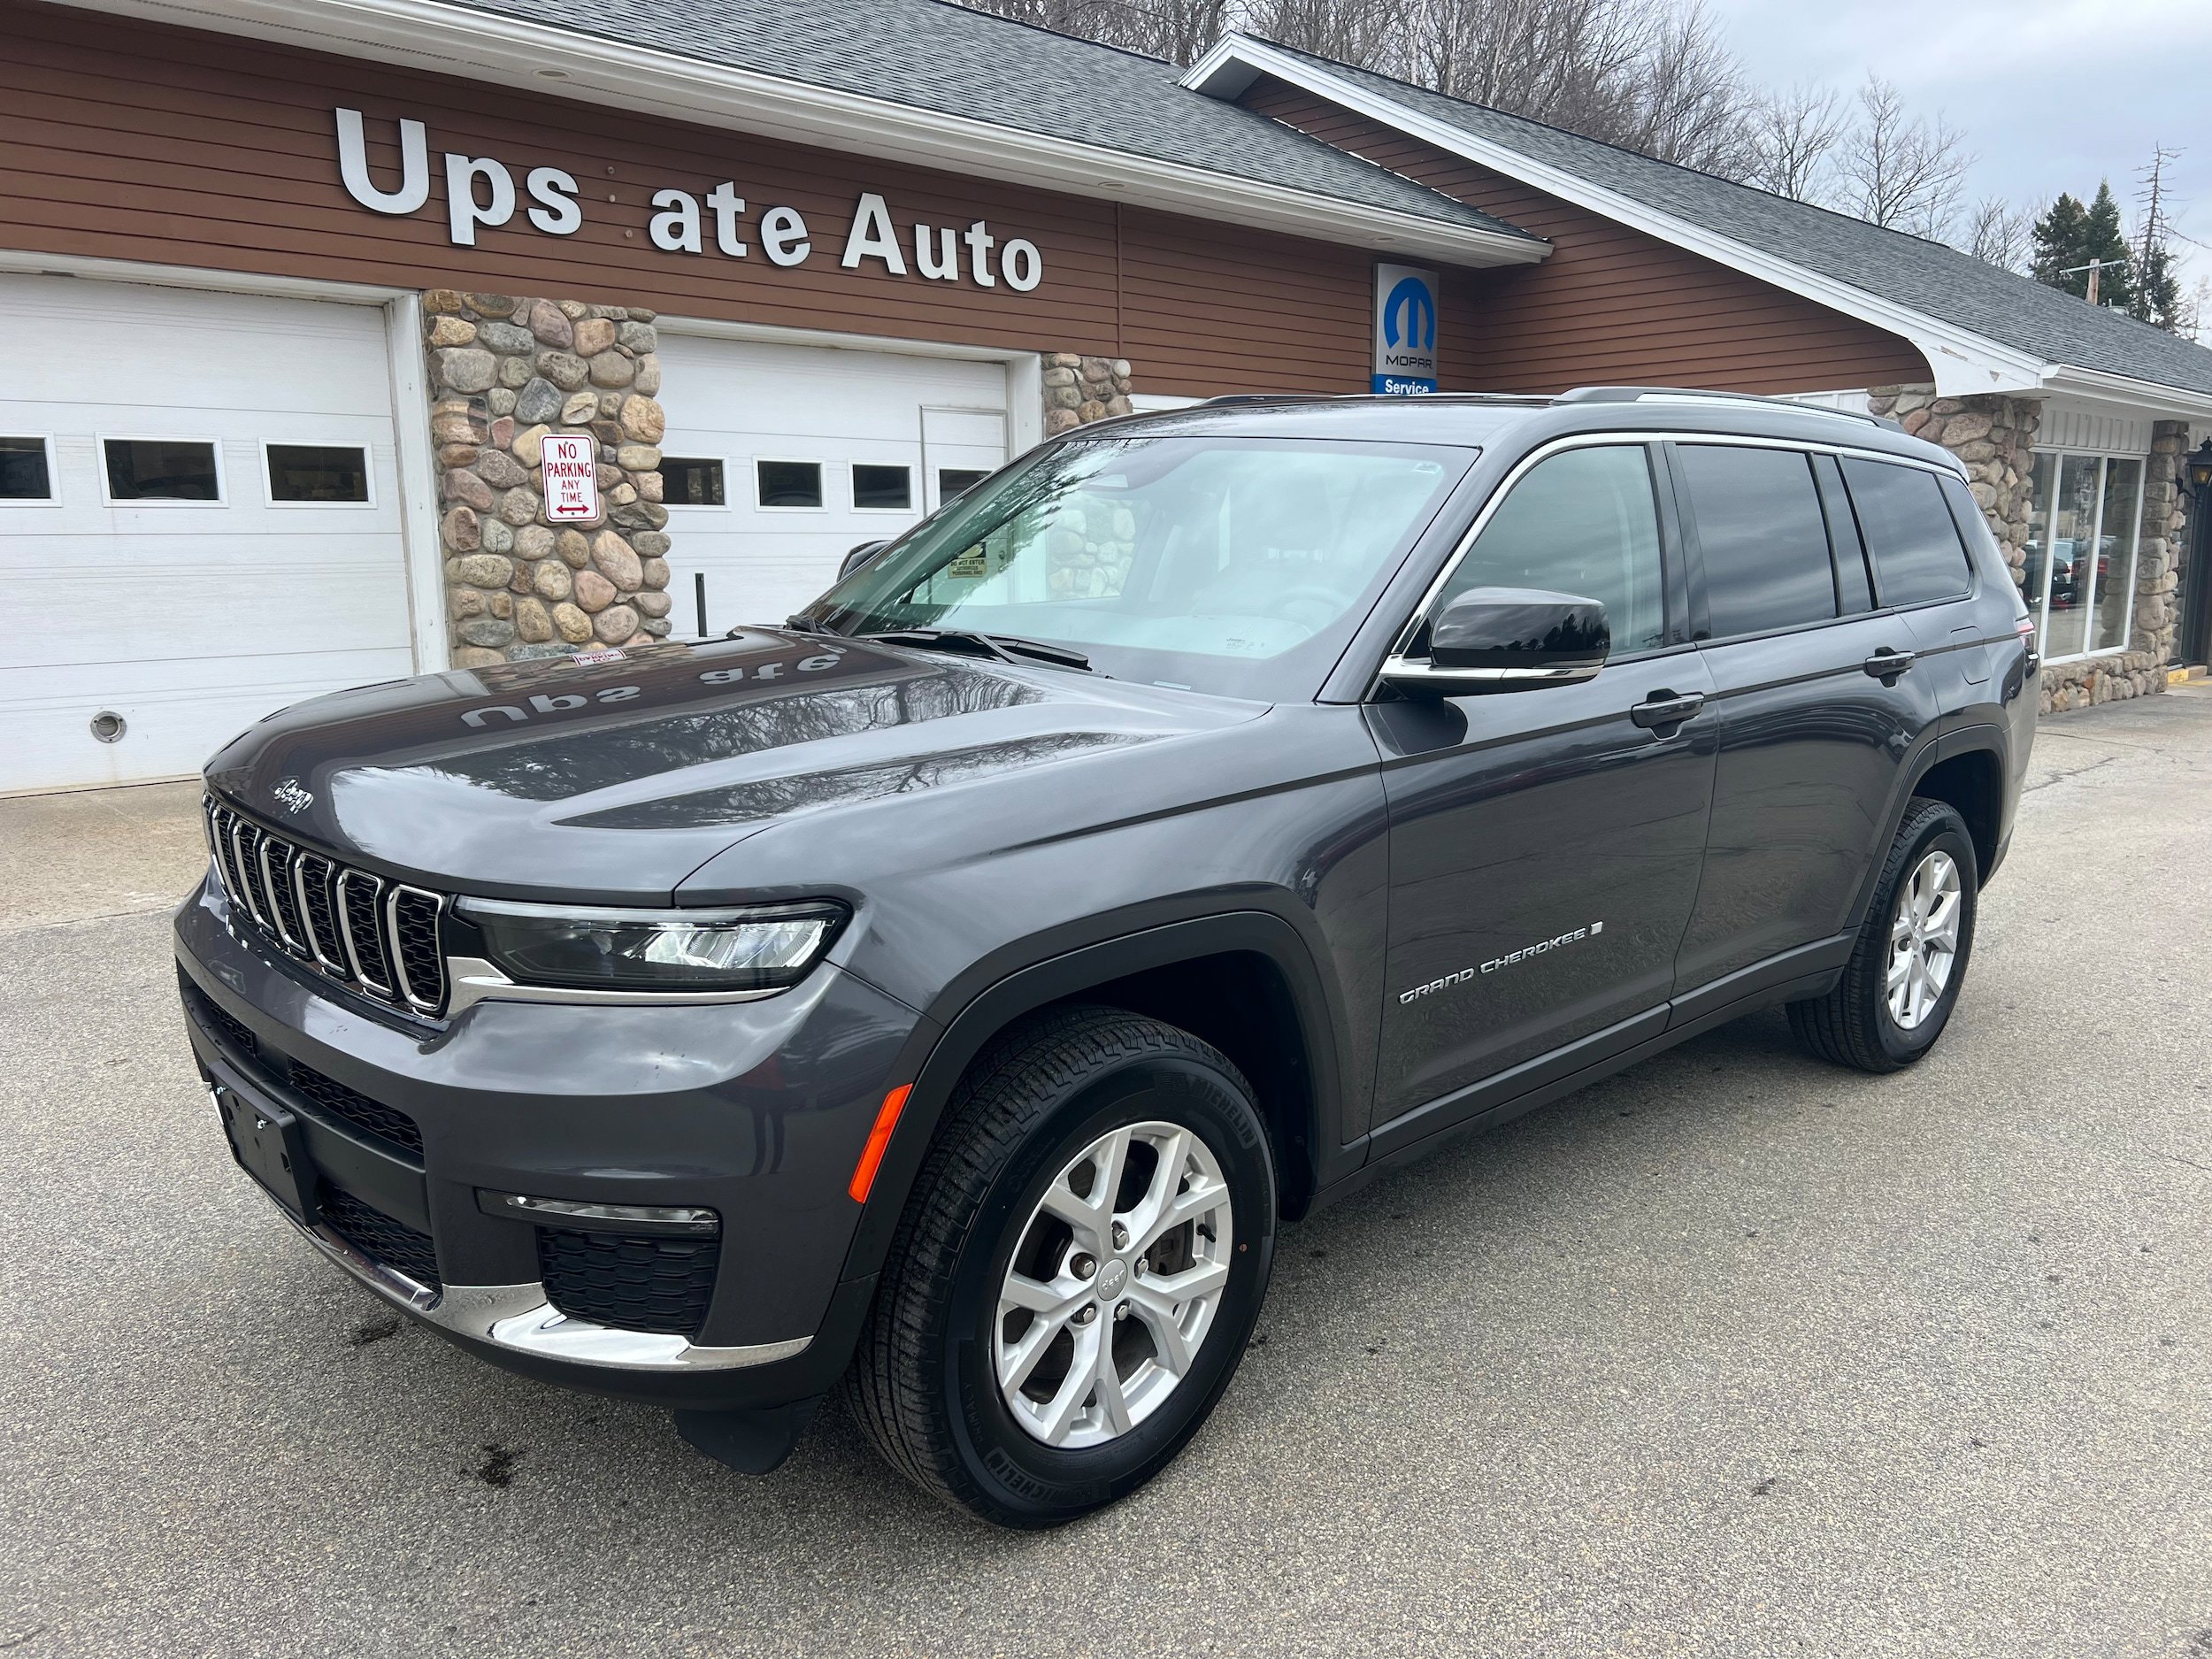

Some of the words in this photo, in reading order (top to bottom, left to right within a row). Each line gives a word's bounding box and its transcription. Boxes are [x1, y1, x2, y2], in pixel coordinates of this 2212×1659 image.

[334, 107, 583, 246] Ups
[649, 180, 811, 266] ate
[841, 192, 1042, 293] Auto
[1386, 355, 1433, 369] MOPAR
[1385, 379, 1430, 395] Service
[558, 443, 577, 458] NO
[547, 462, 591, 478] PARKING
[562, 480, 580, 490] ANY
[561, 492, 583, 503] TIME
[1399, 967, 1475, 1005] GRAND
[1479, 927, 1586, 975] CHEROKEE
